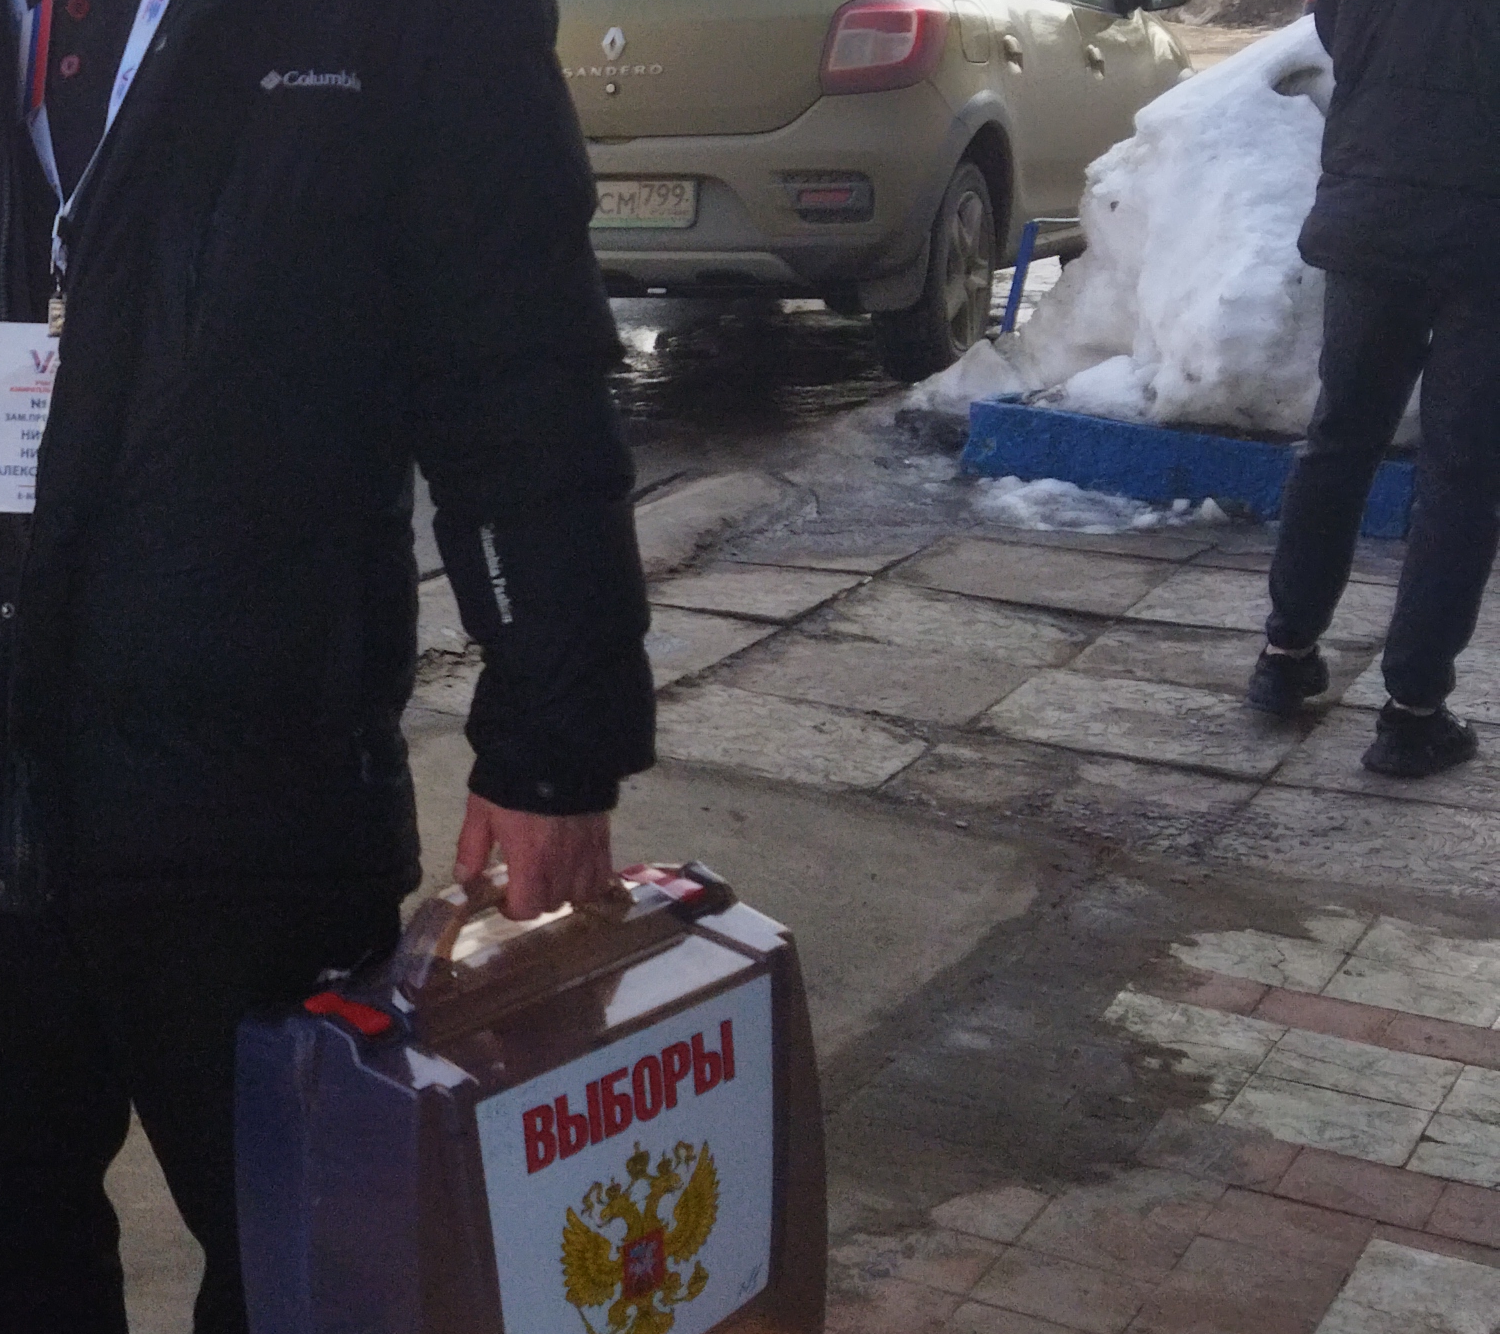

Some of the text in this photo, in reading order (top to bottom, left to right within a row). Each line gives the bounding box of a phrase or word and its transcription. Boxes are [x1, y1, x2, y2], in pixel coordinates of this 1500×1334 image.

[562, 63, 663, 79] SANDERO
[641, 183, 686, 207] 799
[523, 1020, 736, 1174] ВЫБОРЫ
